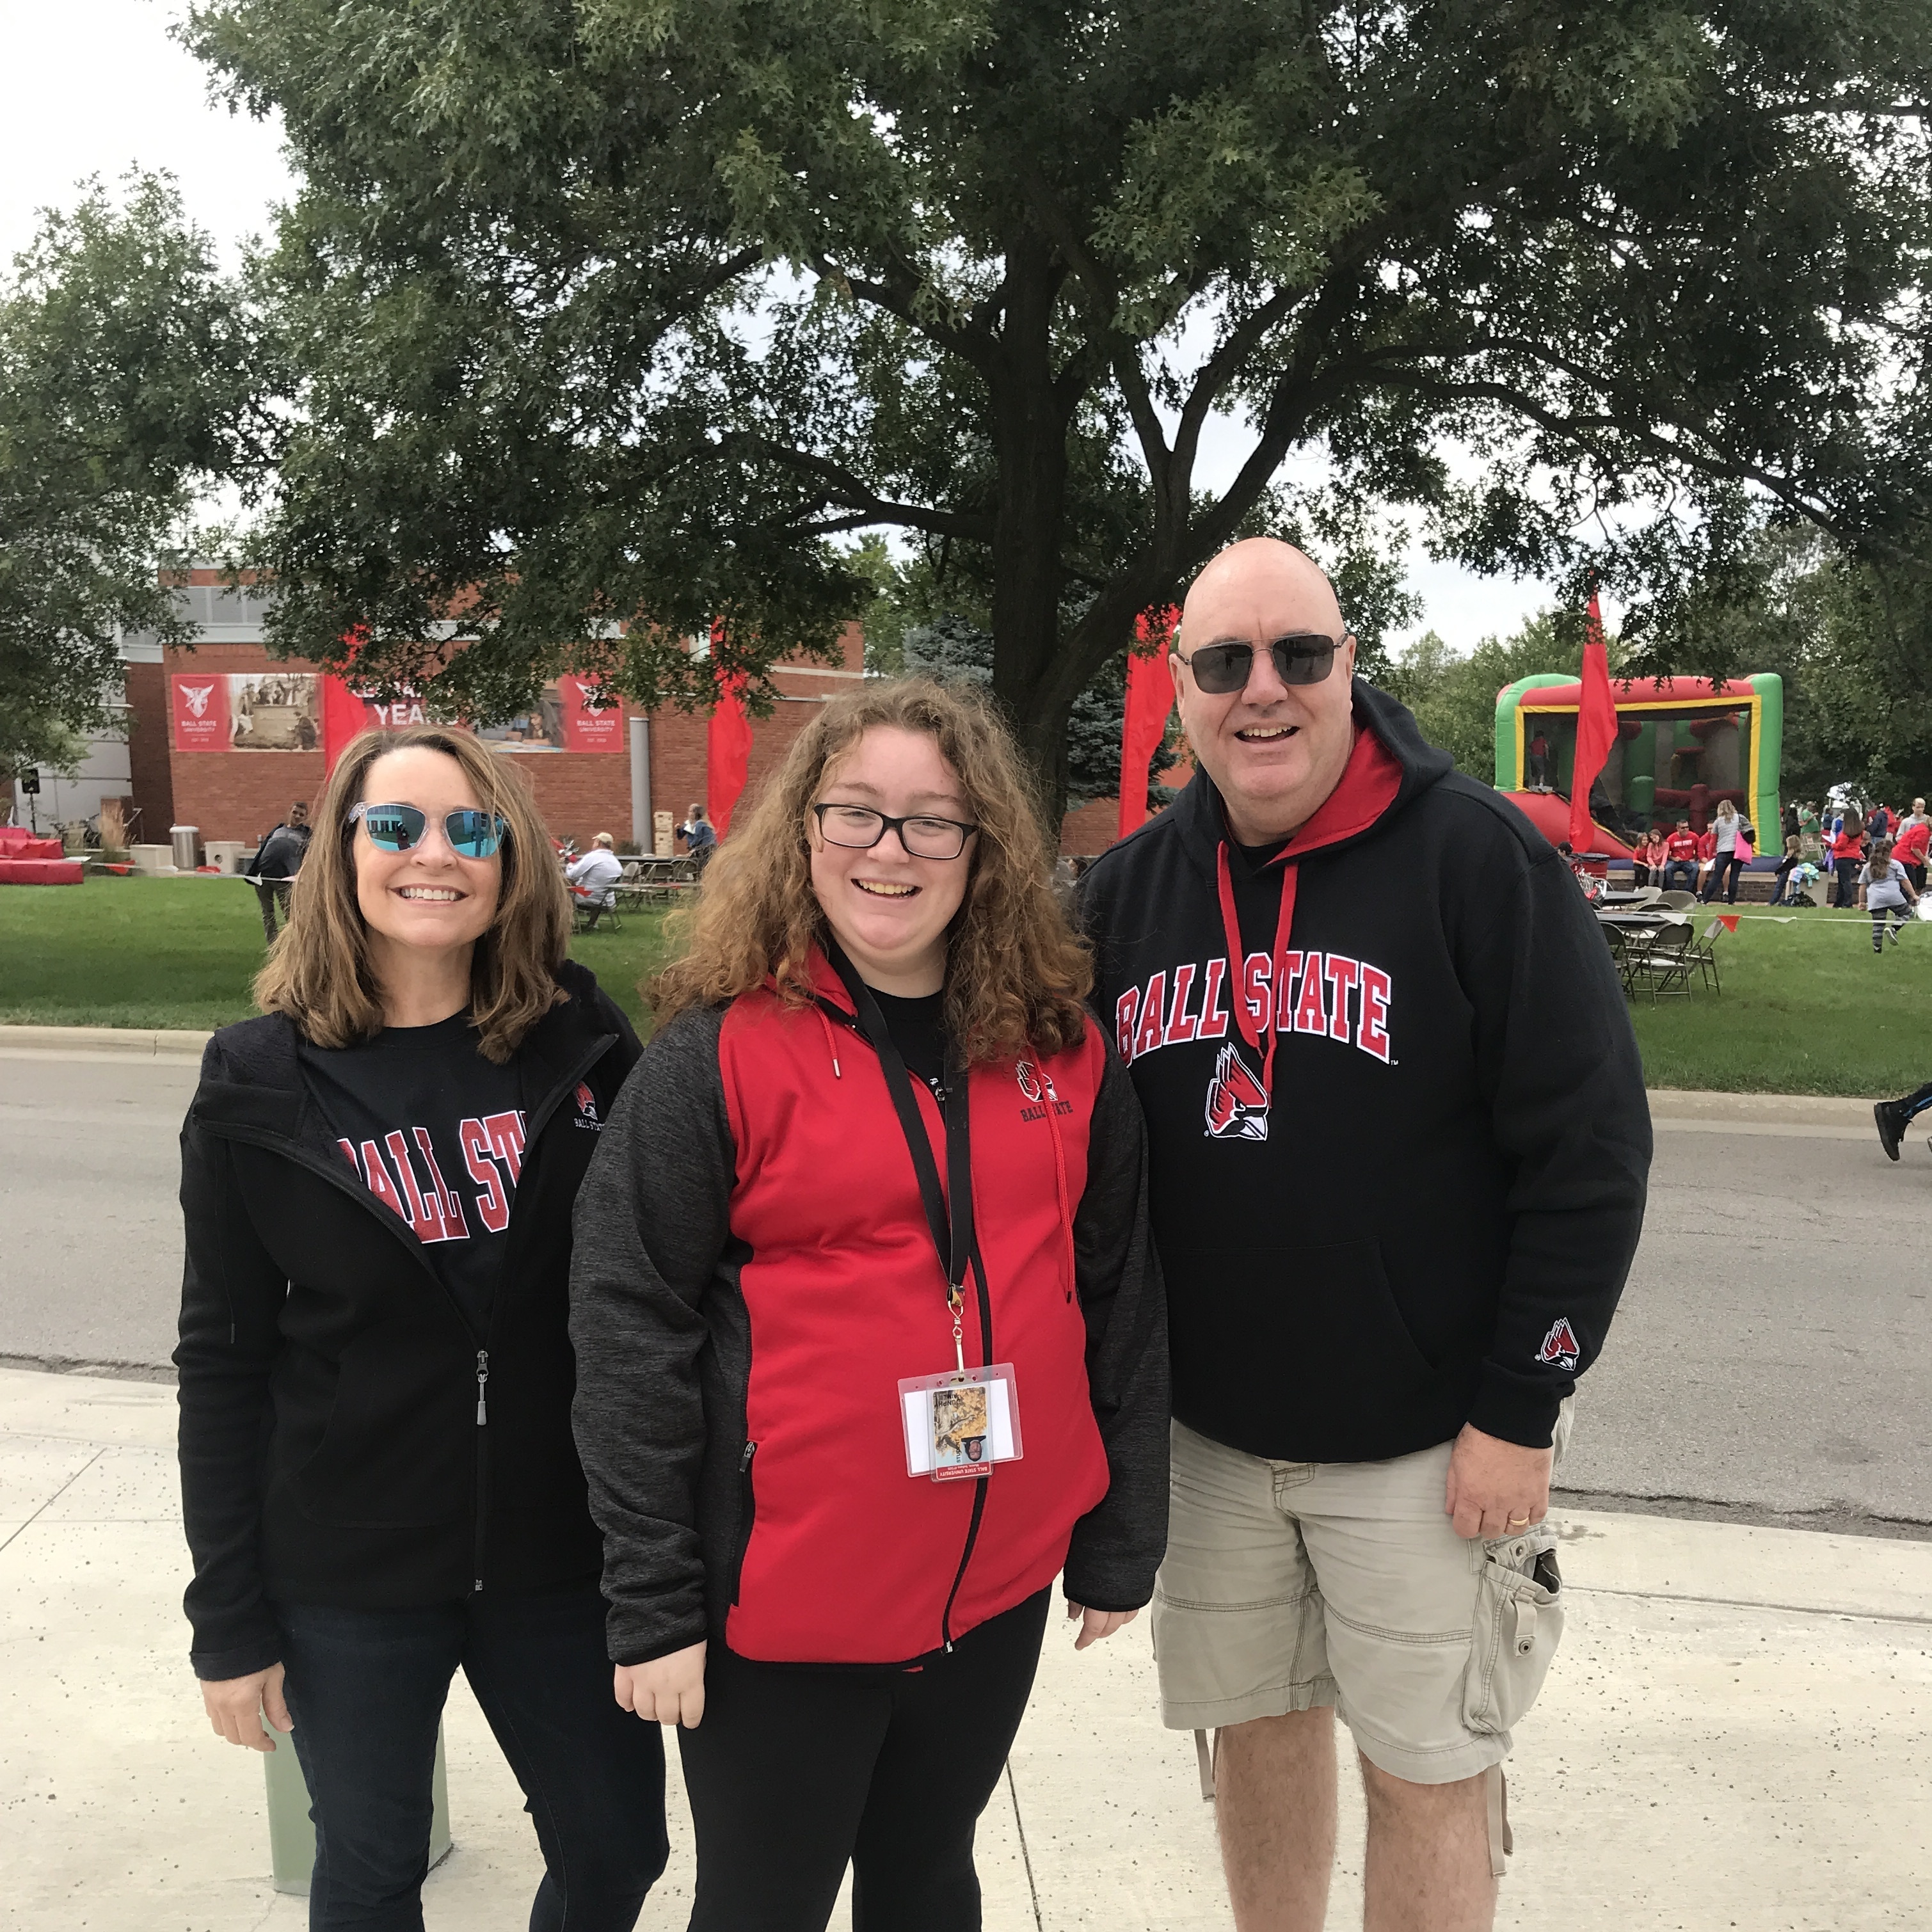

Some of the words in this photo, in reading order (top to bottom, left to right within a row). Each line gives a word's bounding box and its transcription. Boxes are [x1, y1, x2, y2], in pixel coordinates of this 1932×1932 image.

[373, 703, 459, 725] YEA
[1116, 958, 1229, 1067] BALL
[1244, 950, 1391, 1065] STATE
[1020, 1105, 1046, 1122] BALL
[1051, 1100, 1073, 1116] ATE
[589, 1121, 605, 1131] STAT
[459, 1110, 526, 1233] ST
